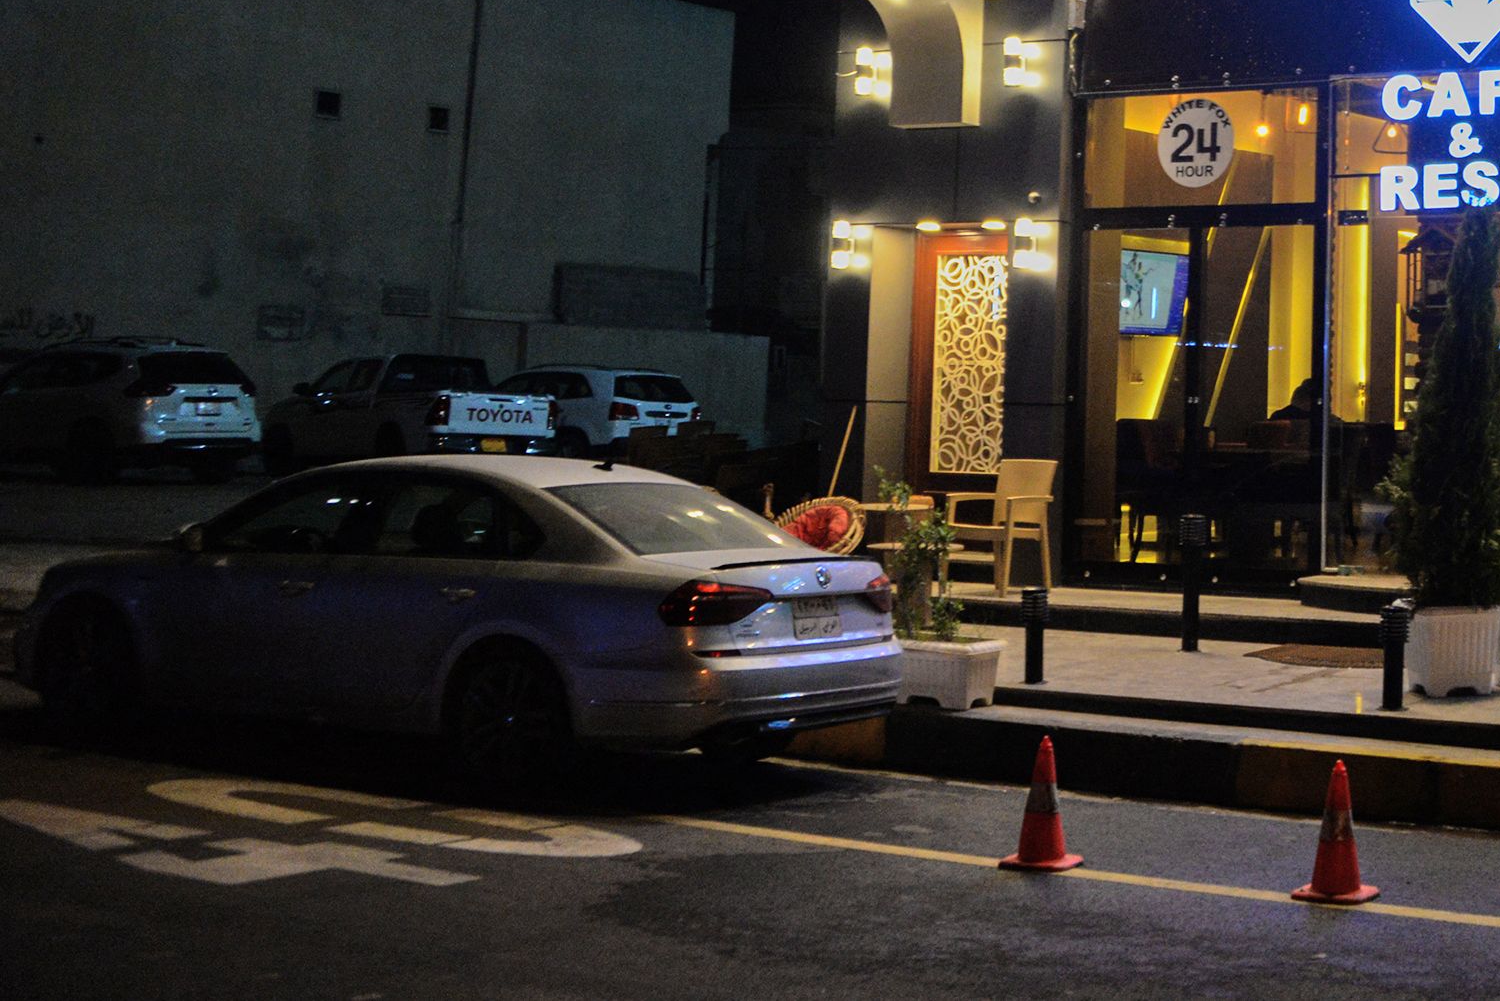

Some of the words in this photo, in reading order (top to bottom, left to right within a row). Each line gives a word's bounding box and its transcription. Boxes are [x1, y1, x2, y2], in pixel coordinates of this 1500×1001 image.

[1163, 99, 1204, 129] WHITE
[1208, 102, 1231, 128] FOX
[1171, 122, 1221, 162] 24
[1448, 122, 1483, 158] &
[1176, 166, 1213, 177] HOUR
[466, 408, 533, 424] TOYOTA
